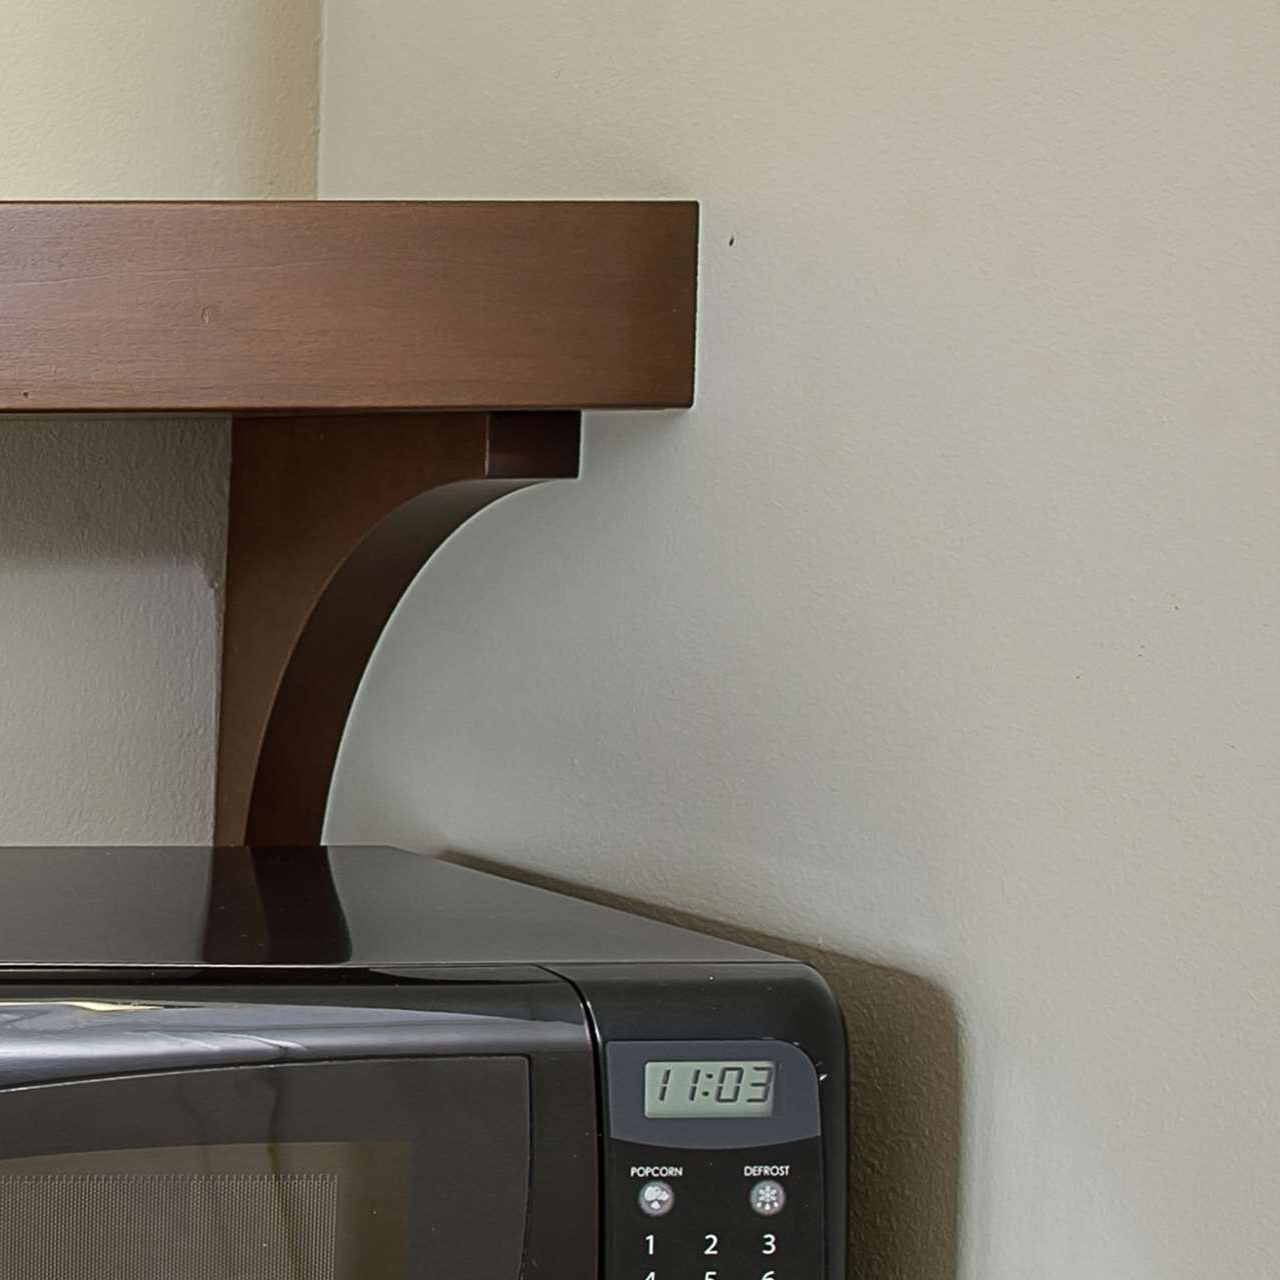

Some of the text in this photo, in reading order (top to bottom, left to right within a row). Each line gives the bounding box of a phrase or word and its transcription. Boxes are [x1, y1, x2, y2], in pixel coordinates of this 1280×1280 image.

[658, 1066, 773, 1103] 11:03
[631, 1167, 683, 1177] POPCORN
[744, 1166, 789, 1176] DEFROST
[645, 1235, 654, 1255] 1
[704, 1234, 718, 1255] 2
[762, 1234, 776, 1254] 3
